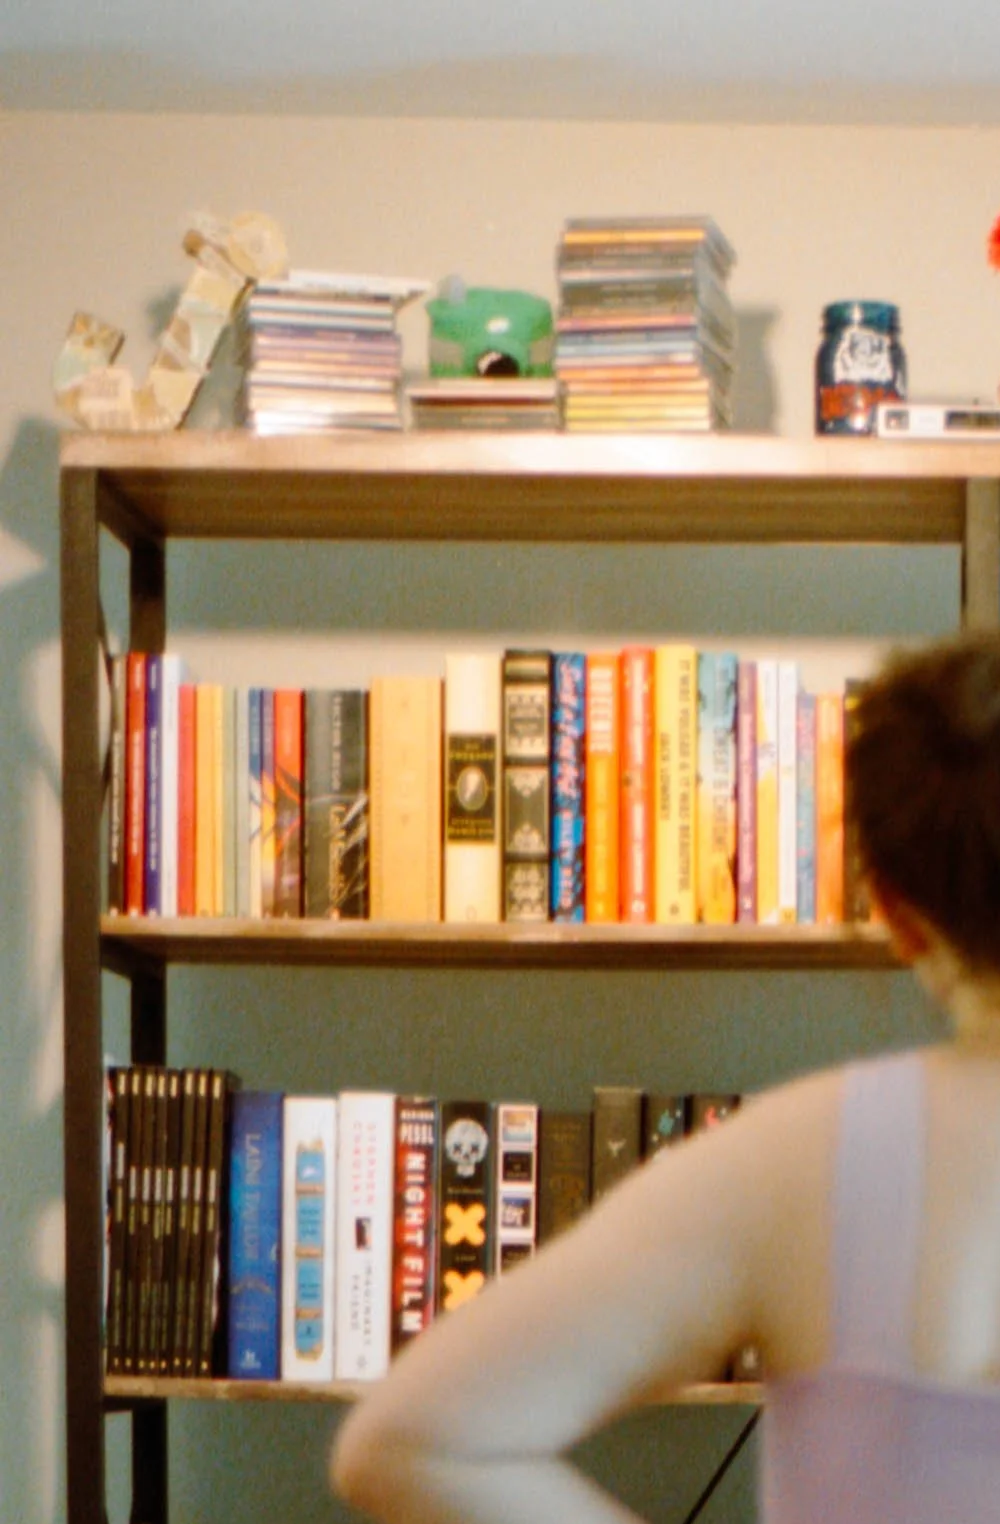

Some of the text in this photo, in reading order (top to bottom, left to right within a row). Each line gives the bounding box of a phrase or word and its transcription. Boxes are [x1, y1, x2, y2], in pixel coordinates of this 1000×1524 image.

[245, 1133, 262, 1260] LAINI TAYLOR
[401, 1152, 426, 1332] NIGHT FILM
